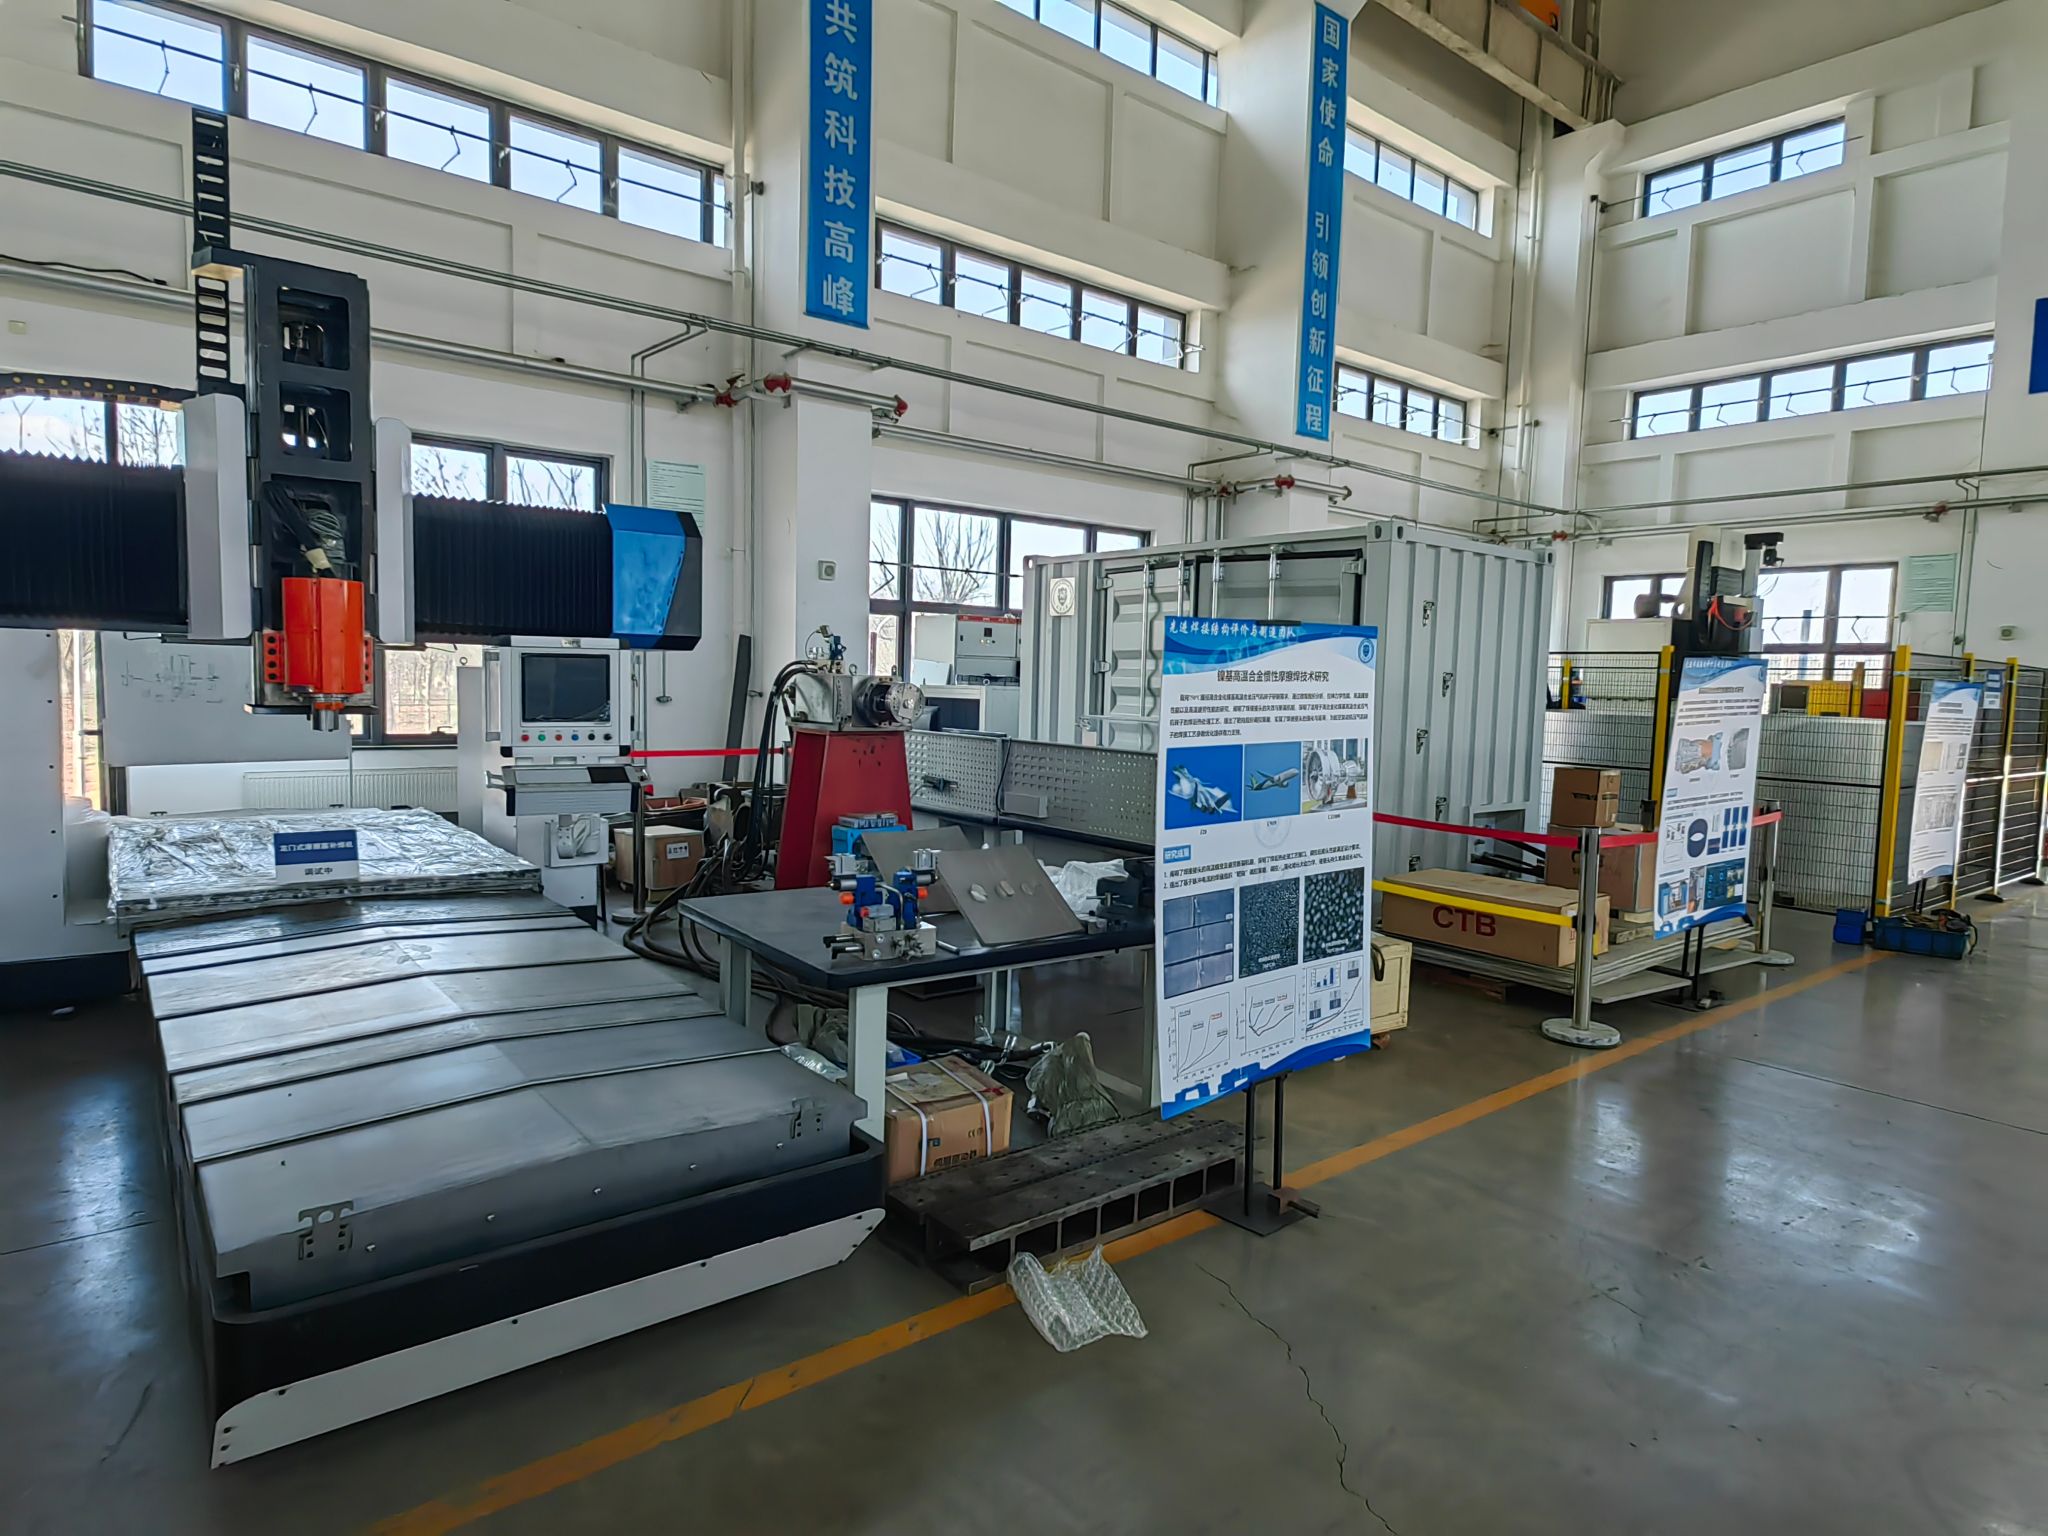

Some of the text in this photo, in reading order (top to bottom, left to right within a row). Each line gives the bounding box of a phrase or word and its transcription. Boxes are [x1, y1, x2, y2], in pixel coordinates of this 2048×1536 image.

[823, 0, 857, 316] 共筑科技高峰
[1305, 16, 1340, 433] 国家使命 引领创新征程
[1432, 906, 1496, 937] CTB
